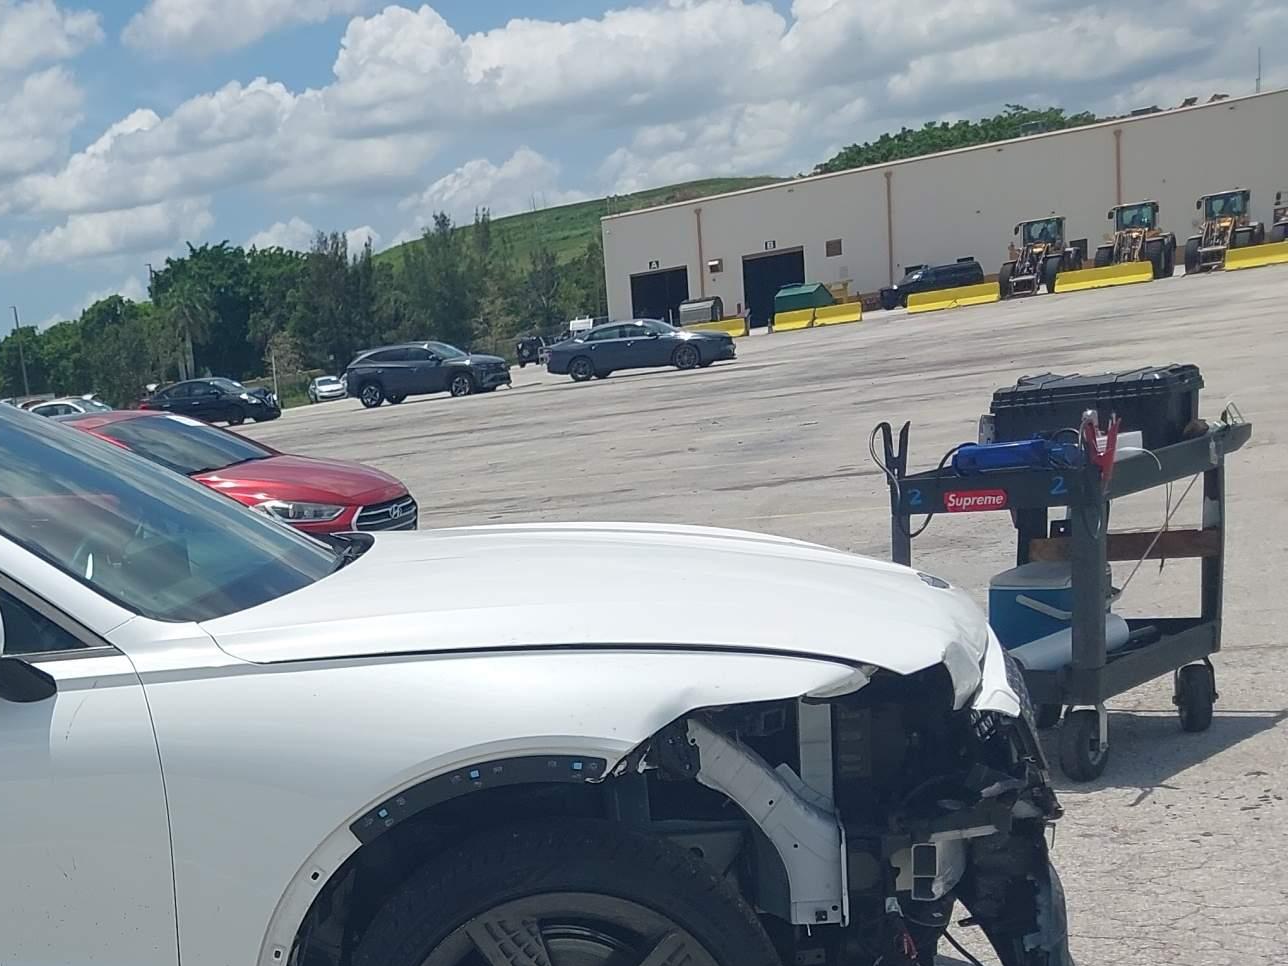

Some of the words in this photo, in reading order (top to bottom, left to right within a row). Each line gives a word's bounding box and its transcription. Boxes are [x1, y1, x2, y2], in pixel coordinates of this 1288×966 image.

[1050, 476, 1067, 495] 2
[908, 488, 922, 505] 2
[947, 492, 1004, 509] Supreme
